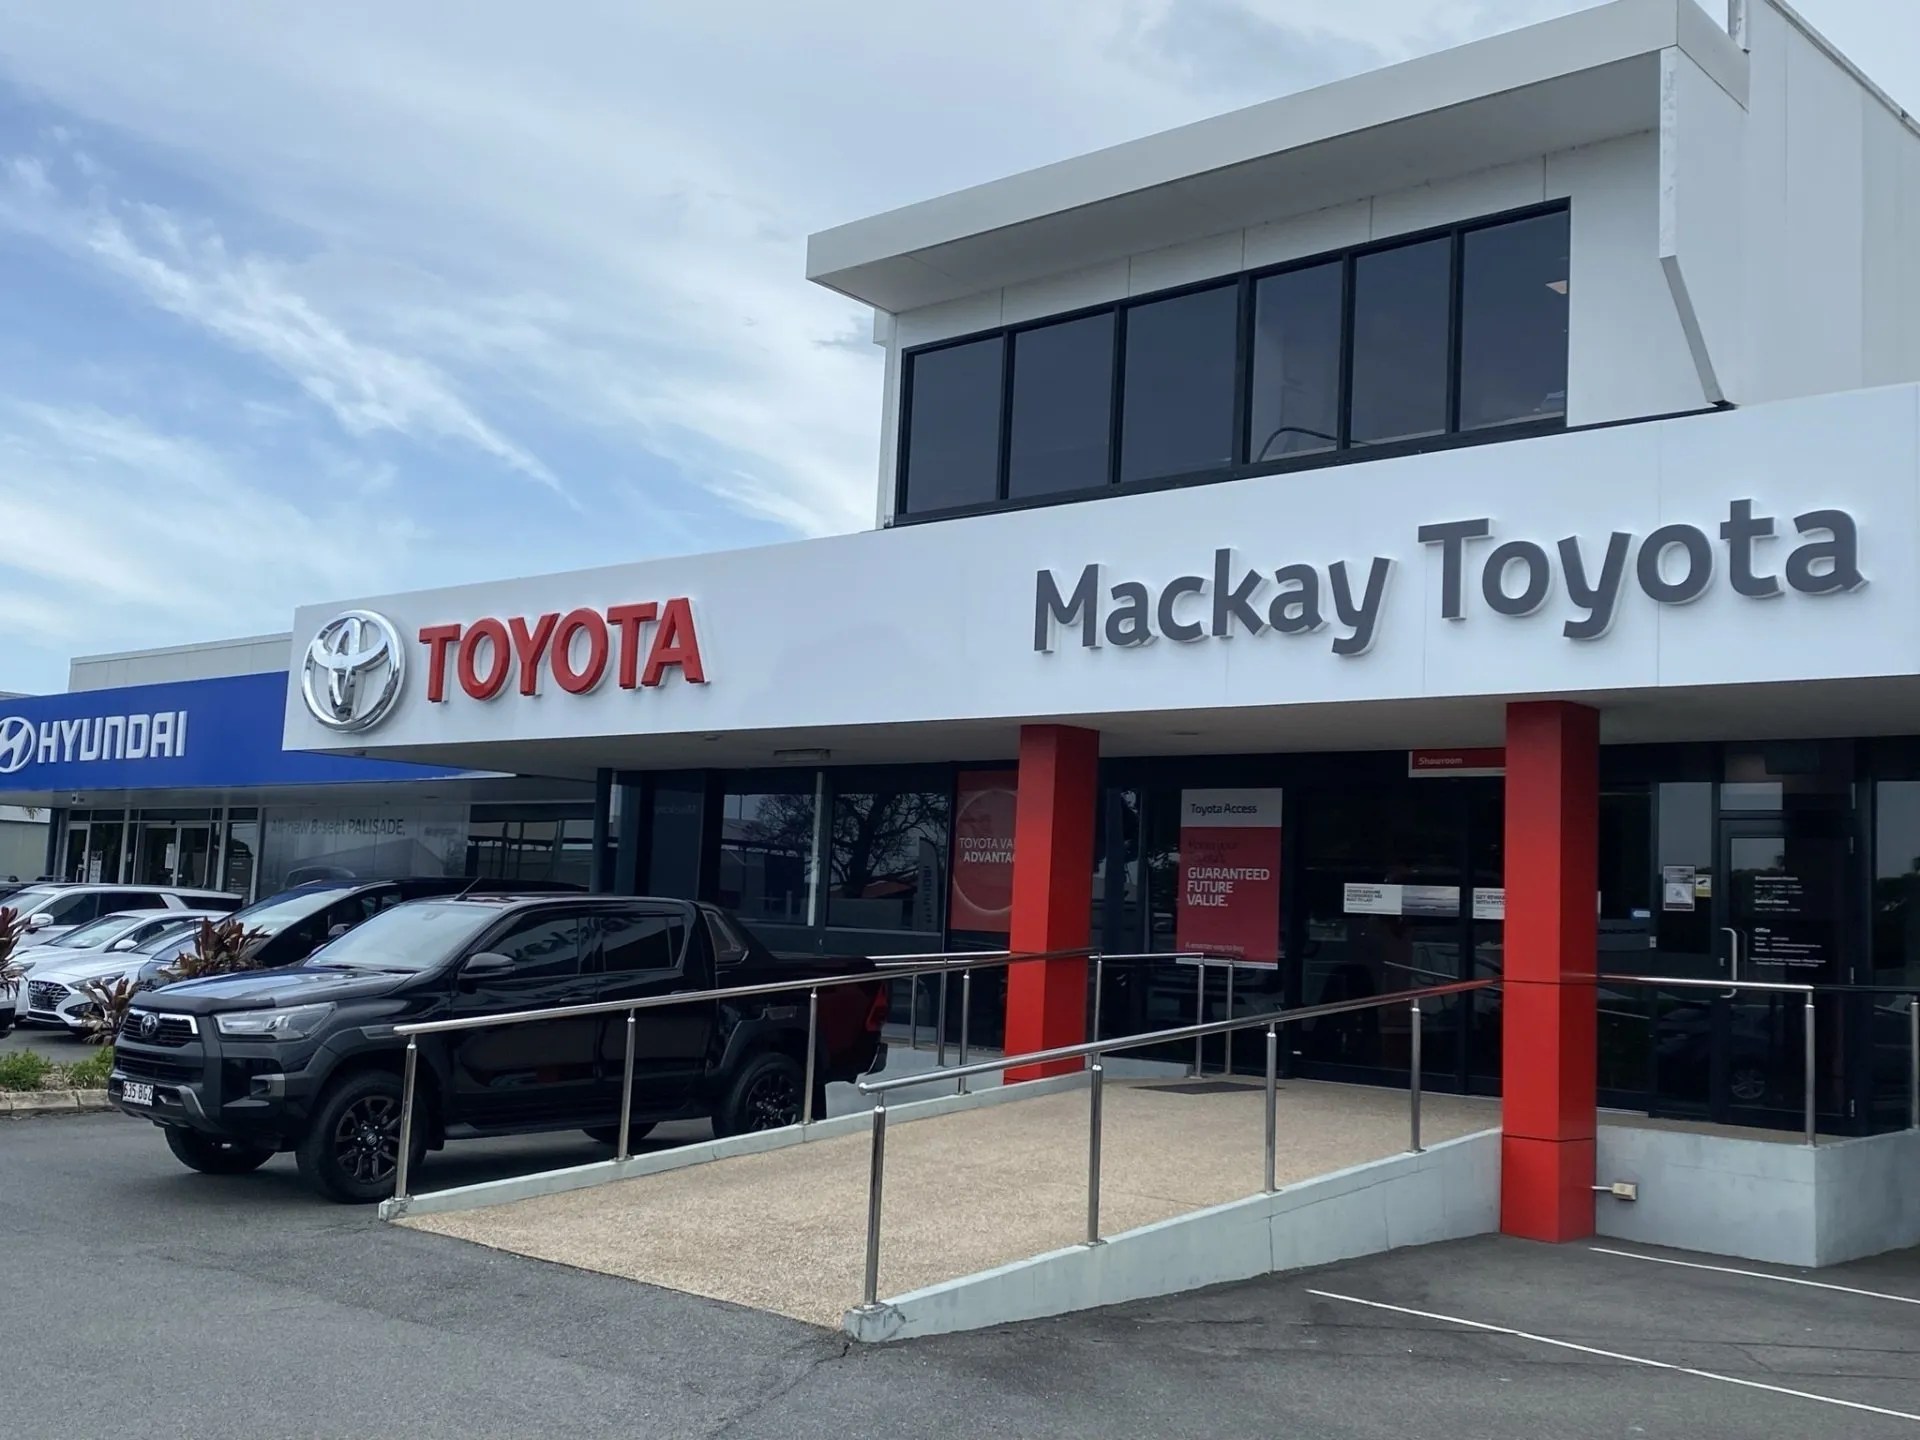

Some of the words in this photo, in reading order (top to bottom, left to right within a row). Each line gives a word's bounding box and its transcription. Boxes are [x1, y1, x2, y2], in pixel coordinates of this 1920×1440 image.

[1033, 547, 1398, 656] Mackay
[1417, 498, 1870, 640] Toyota
[419, 597, 708, 703] TOYOTA
[37, 711, 188, 764] HYUNDAI
[1418, 757, 1463, 766] Showroom
[1190, 803, 1222, 816] Toyota
[1223, 803, 1258, 814] Access
[349, 818, 406, 837] PALISADE,
[959, 837, 999, 849] TOYOTA
[999, 837, 1016, 849] VA
[1187, 867, 1270, 880] GUARANTEED
[1186, 880, 1234, 893] FUTURE
[1186, 893, 1228, 907] VALUE.
